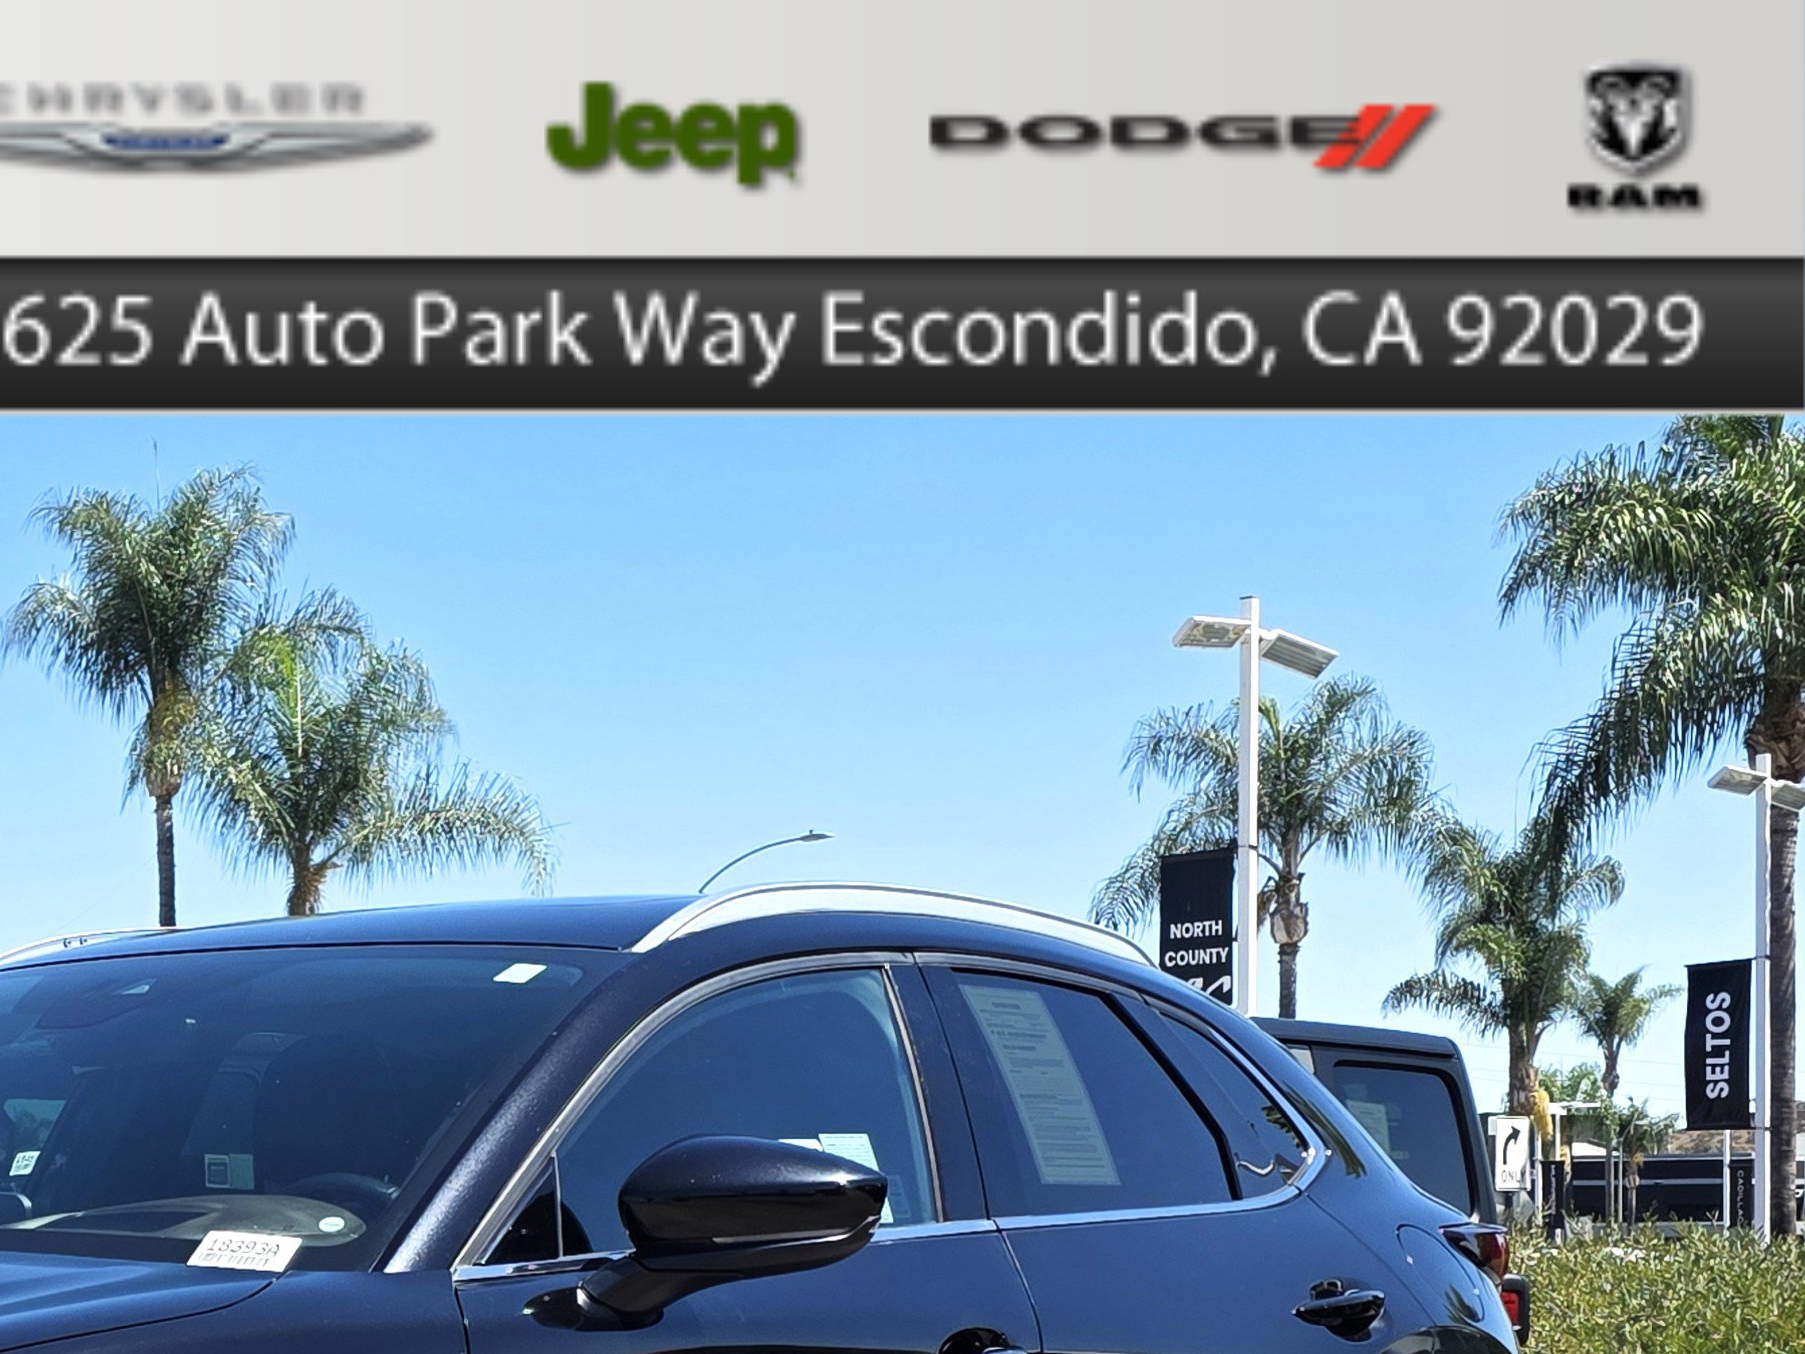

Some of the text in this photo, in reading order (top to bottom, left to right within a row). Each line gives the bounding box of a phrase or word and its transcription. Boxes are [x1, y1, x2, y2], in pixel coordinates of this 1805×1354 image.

[1170, 920, 1222, 939] NORTH
[1165, 947, 1229, 967] COUNTY
[1705, 991, 1731, 1099] SELTOS
